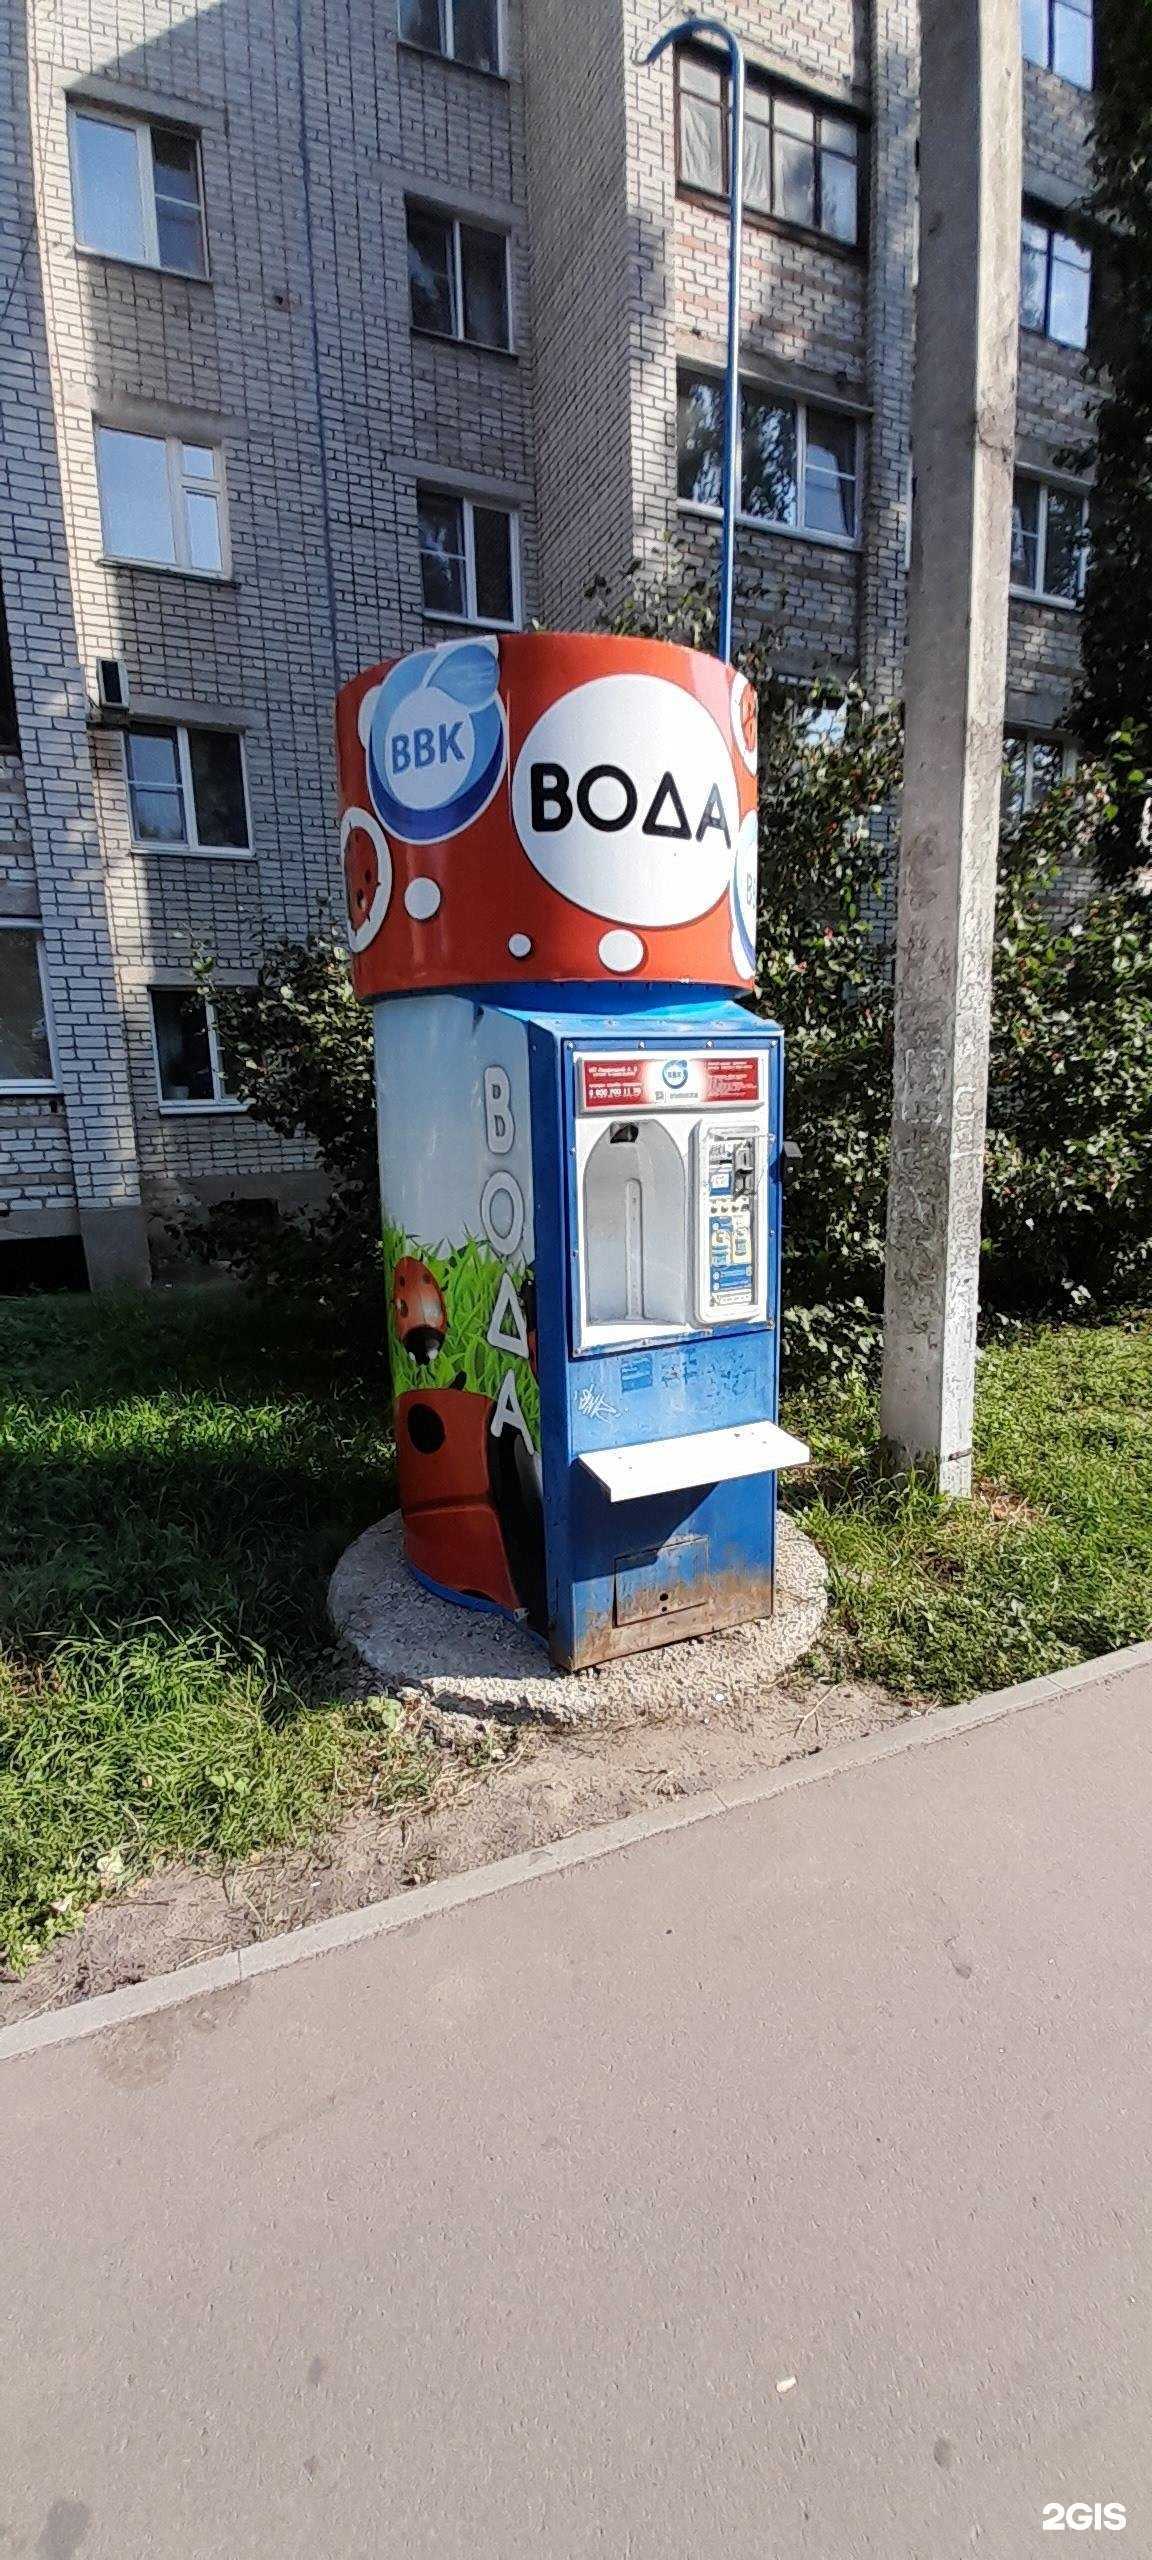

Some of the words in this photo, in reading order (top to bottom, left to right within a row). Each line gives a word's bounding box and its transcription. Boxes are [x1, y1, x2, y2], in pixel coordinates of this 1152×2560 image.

[391, 720, 467, 775] ВВК
[529, 762, 731, 849] ВОДА
[479, 1064, 535, 1456] ВОДА
